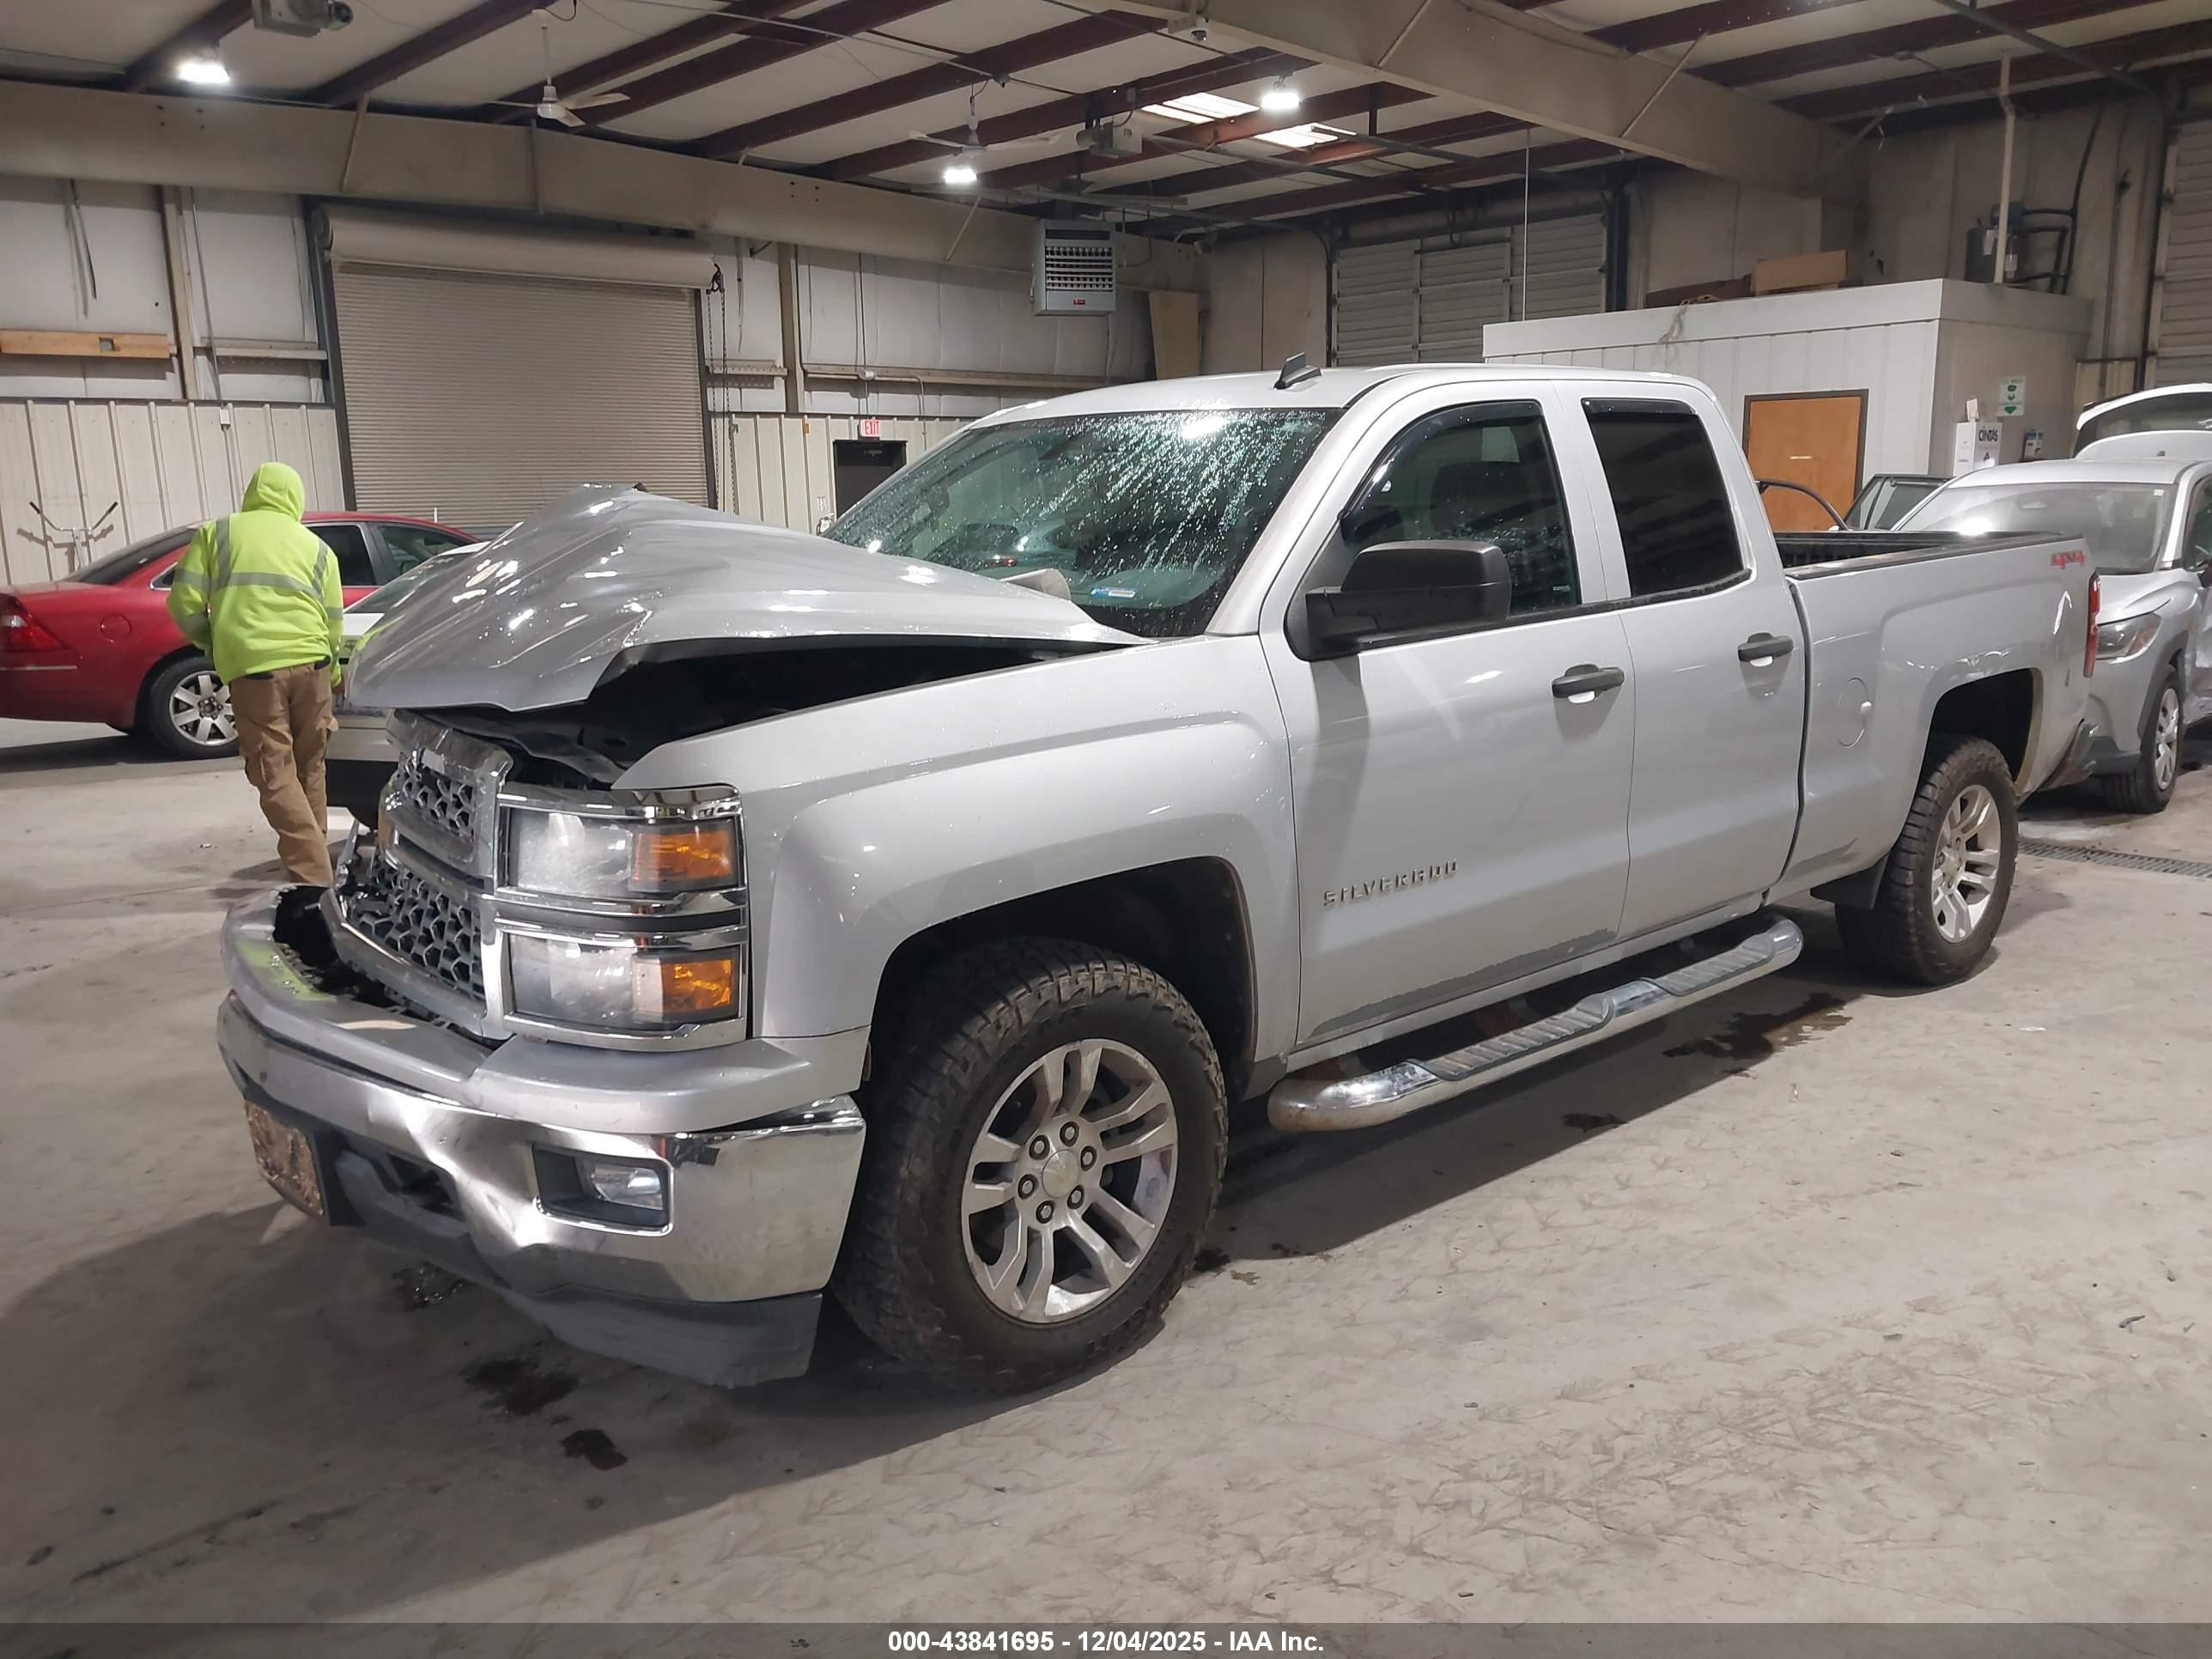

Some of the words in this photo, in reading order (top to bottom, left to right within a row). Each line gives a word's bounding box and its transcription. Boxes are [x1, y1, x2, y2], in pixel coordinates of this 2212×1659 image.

[865, 420, 880, 435] EXIT
[1978, 426, 1999, 442] CINTAS
[1322, 858, 1459, 907] SILVERADO
